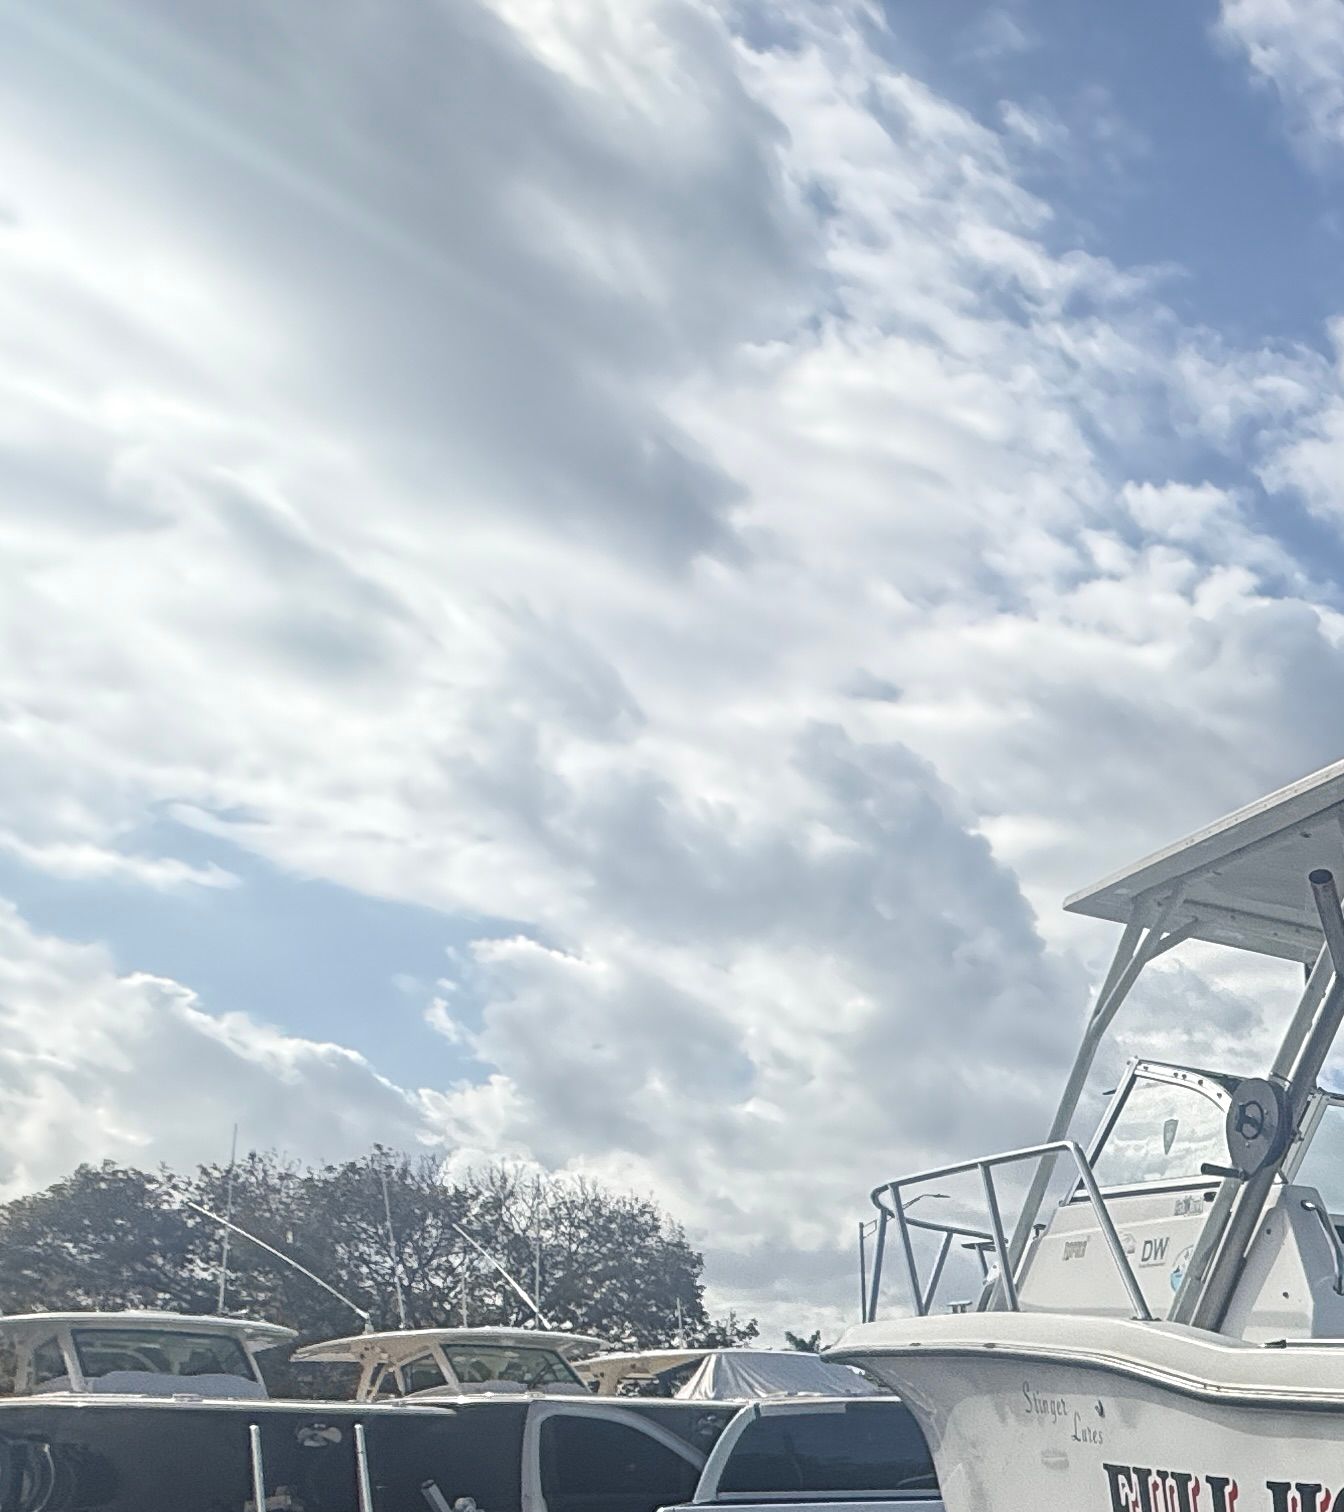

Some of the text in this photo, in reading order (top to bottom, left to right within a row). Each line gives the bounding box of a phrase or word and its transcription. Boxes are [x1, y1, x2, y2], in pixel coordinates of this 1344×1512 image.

[1141, 1237, 1170, 1263] DW
[1022, 1380, 1068, 1424] Stinger
[1071, 1411, 1104, 1445] Lures
